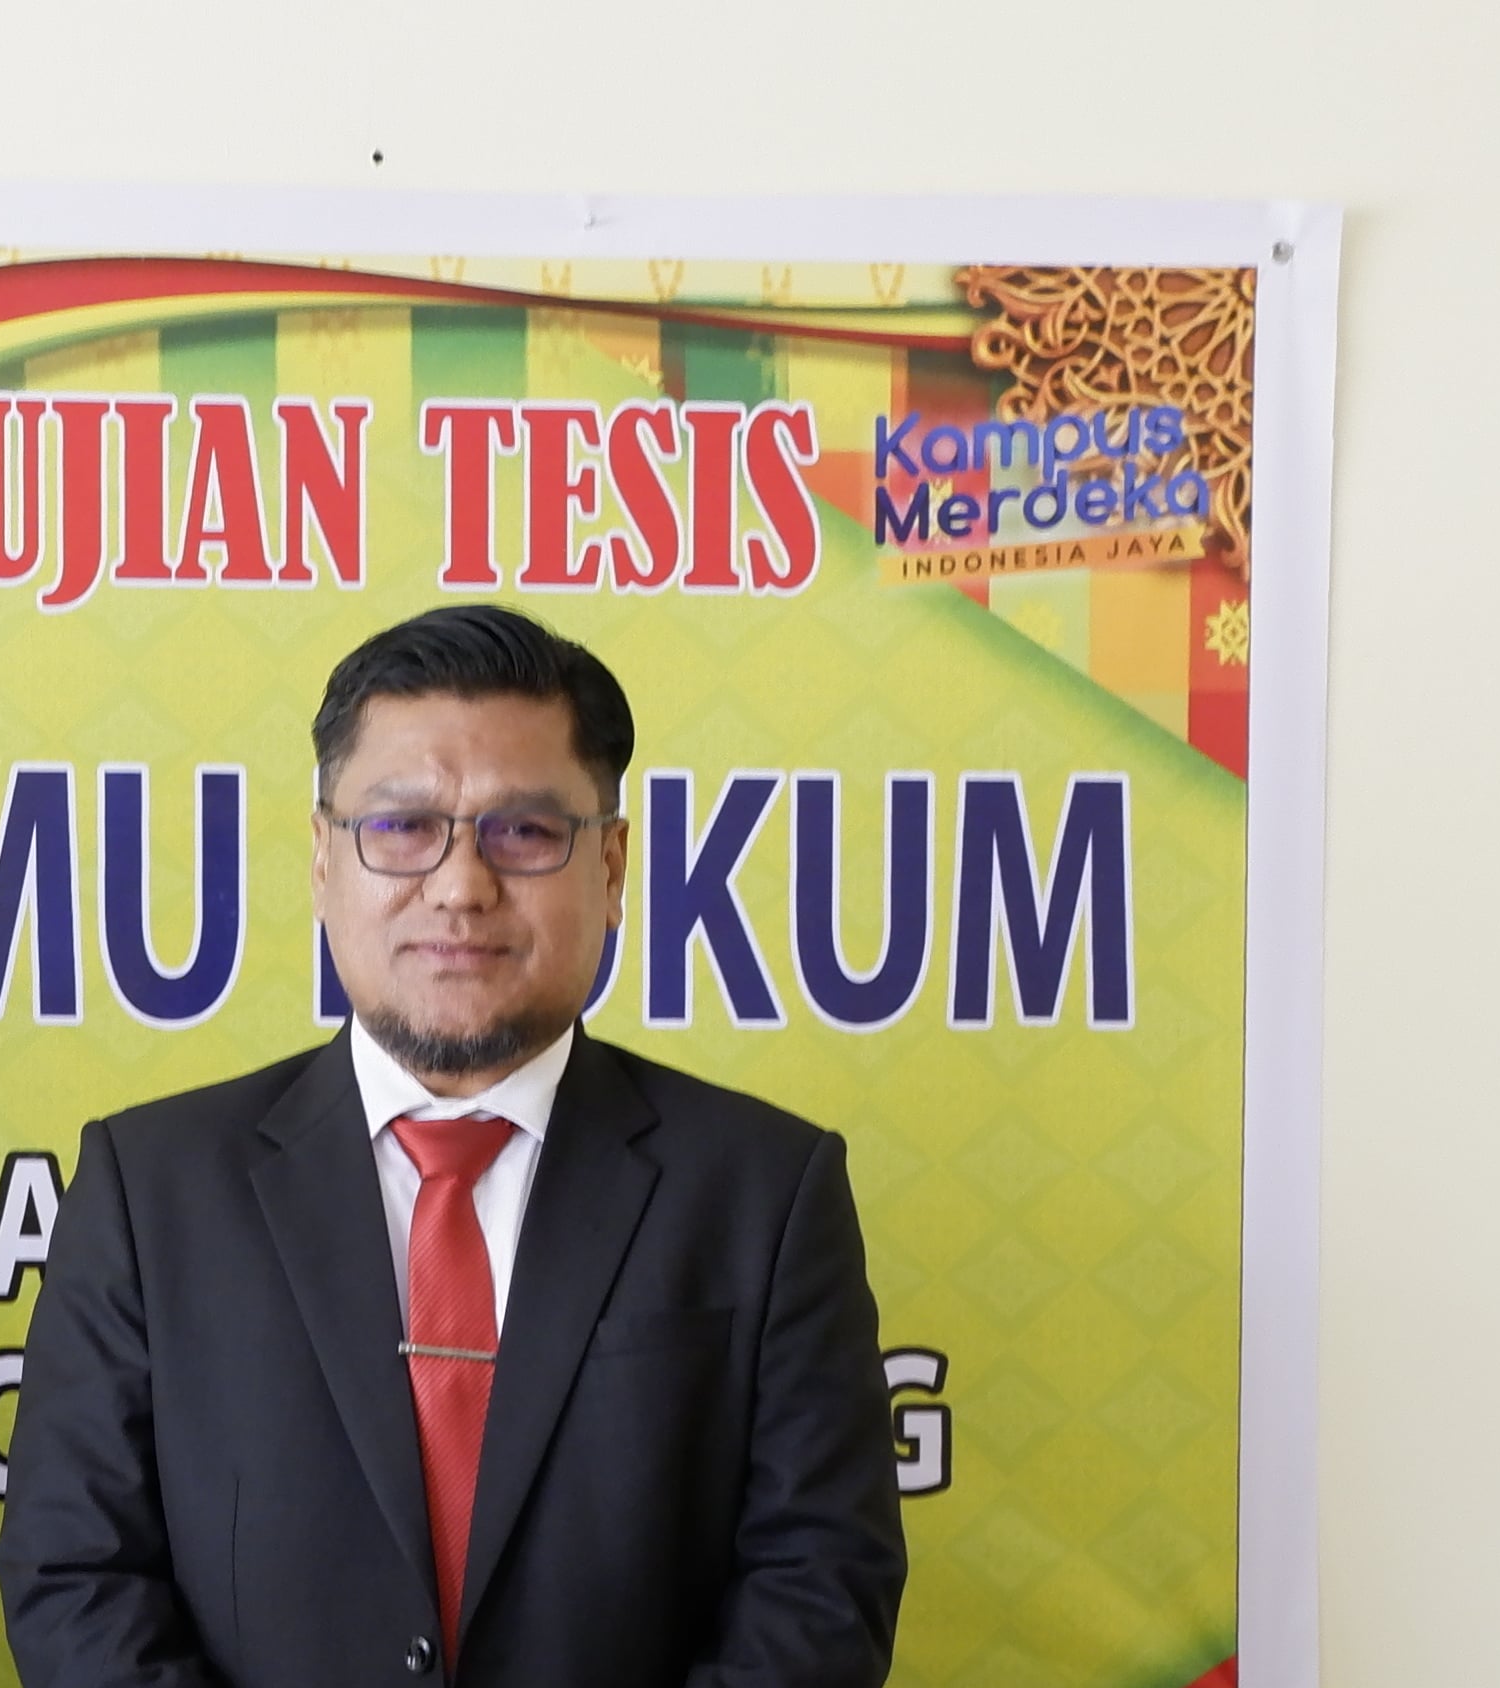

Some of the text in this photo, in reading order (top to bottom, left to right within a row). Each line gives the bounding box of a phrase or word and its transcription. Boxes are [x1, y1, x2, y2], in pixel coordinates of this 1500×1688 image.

[874, 405, 1185, 481] Kampus
[422, 399, 822, 596] TESIS
[874, 461, 1210, 546] Merdeka
[901, 533, 1186, 578] INDONESIA JAYA
[313, 767, 1133, 1028] KUM
